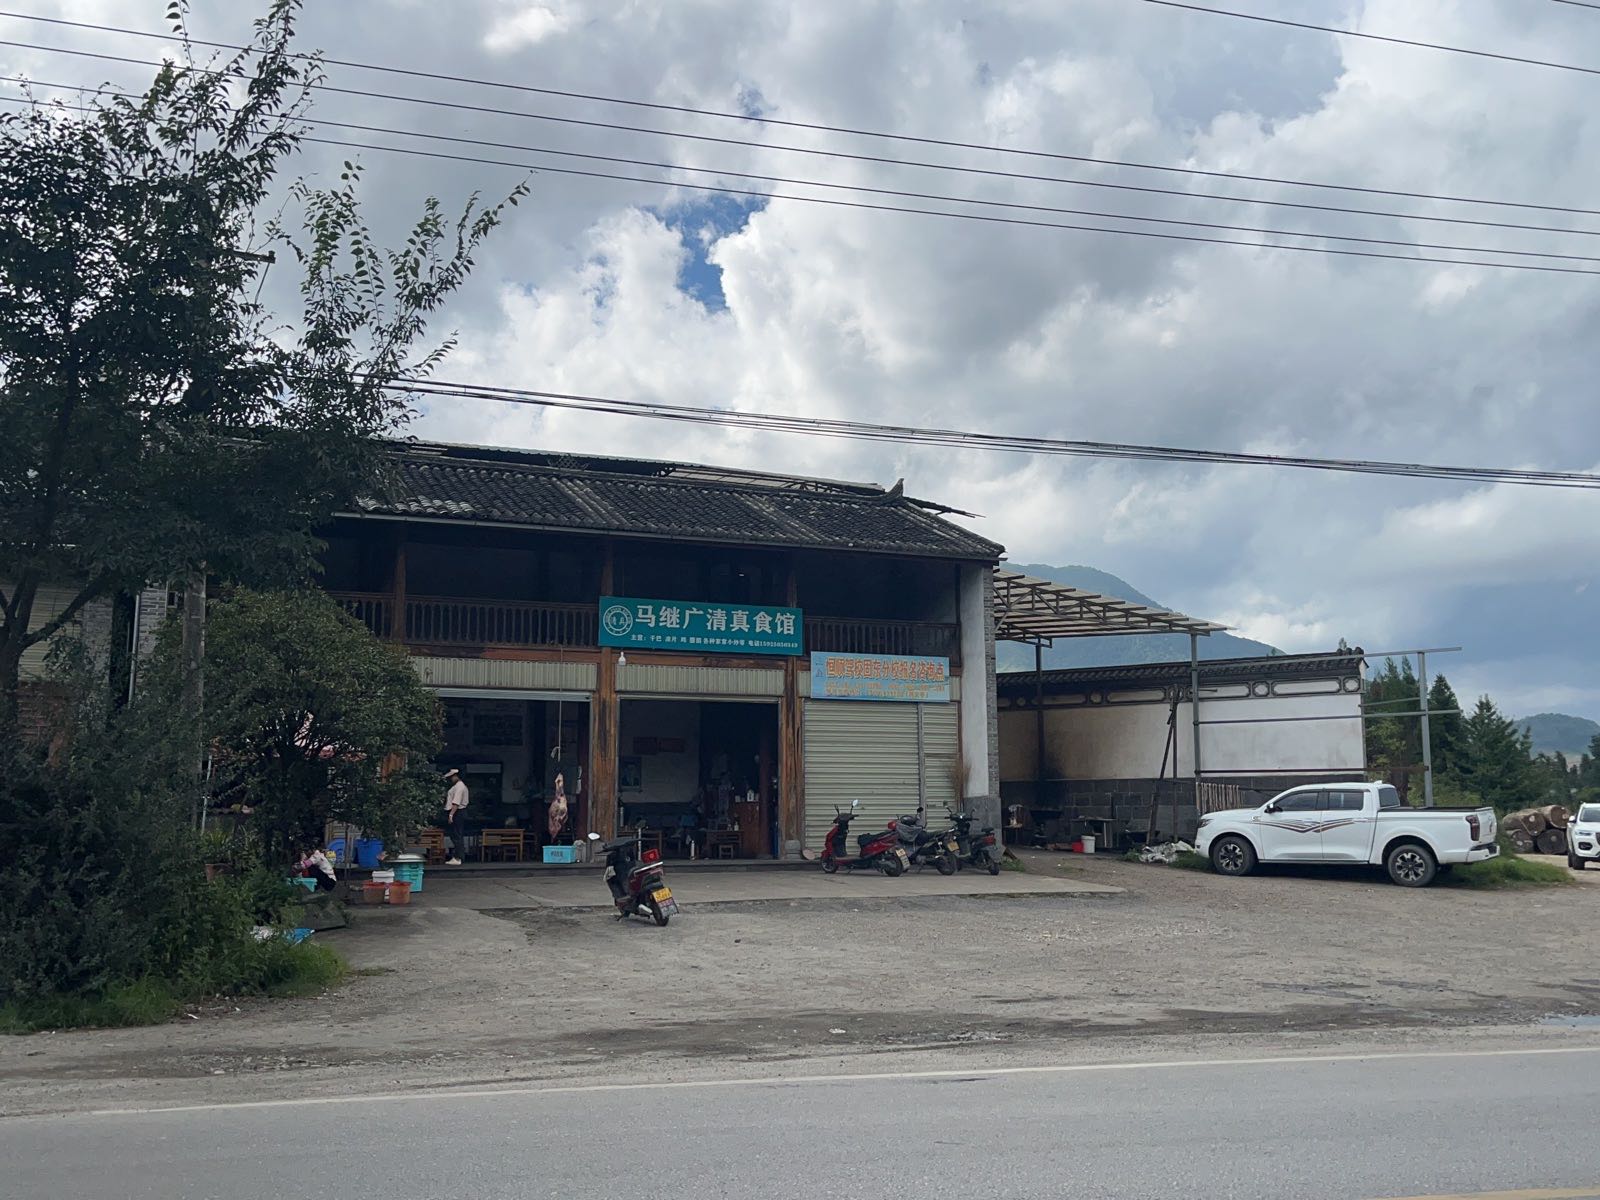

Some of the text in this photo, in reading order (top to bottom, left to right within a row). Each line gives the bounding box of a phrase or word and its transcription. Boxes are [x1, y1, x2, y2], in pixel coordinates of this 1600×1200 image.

[635, 605, 796, 635] 马继广清真食馆
